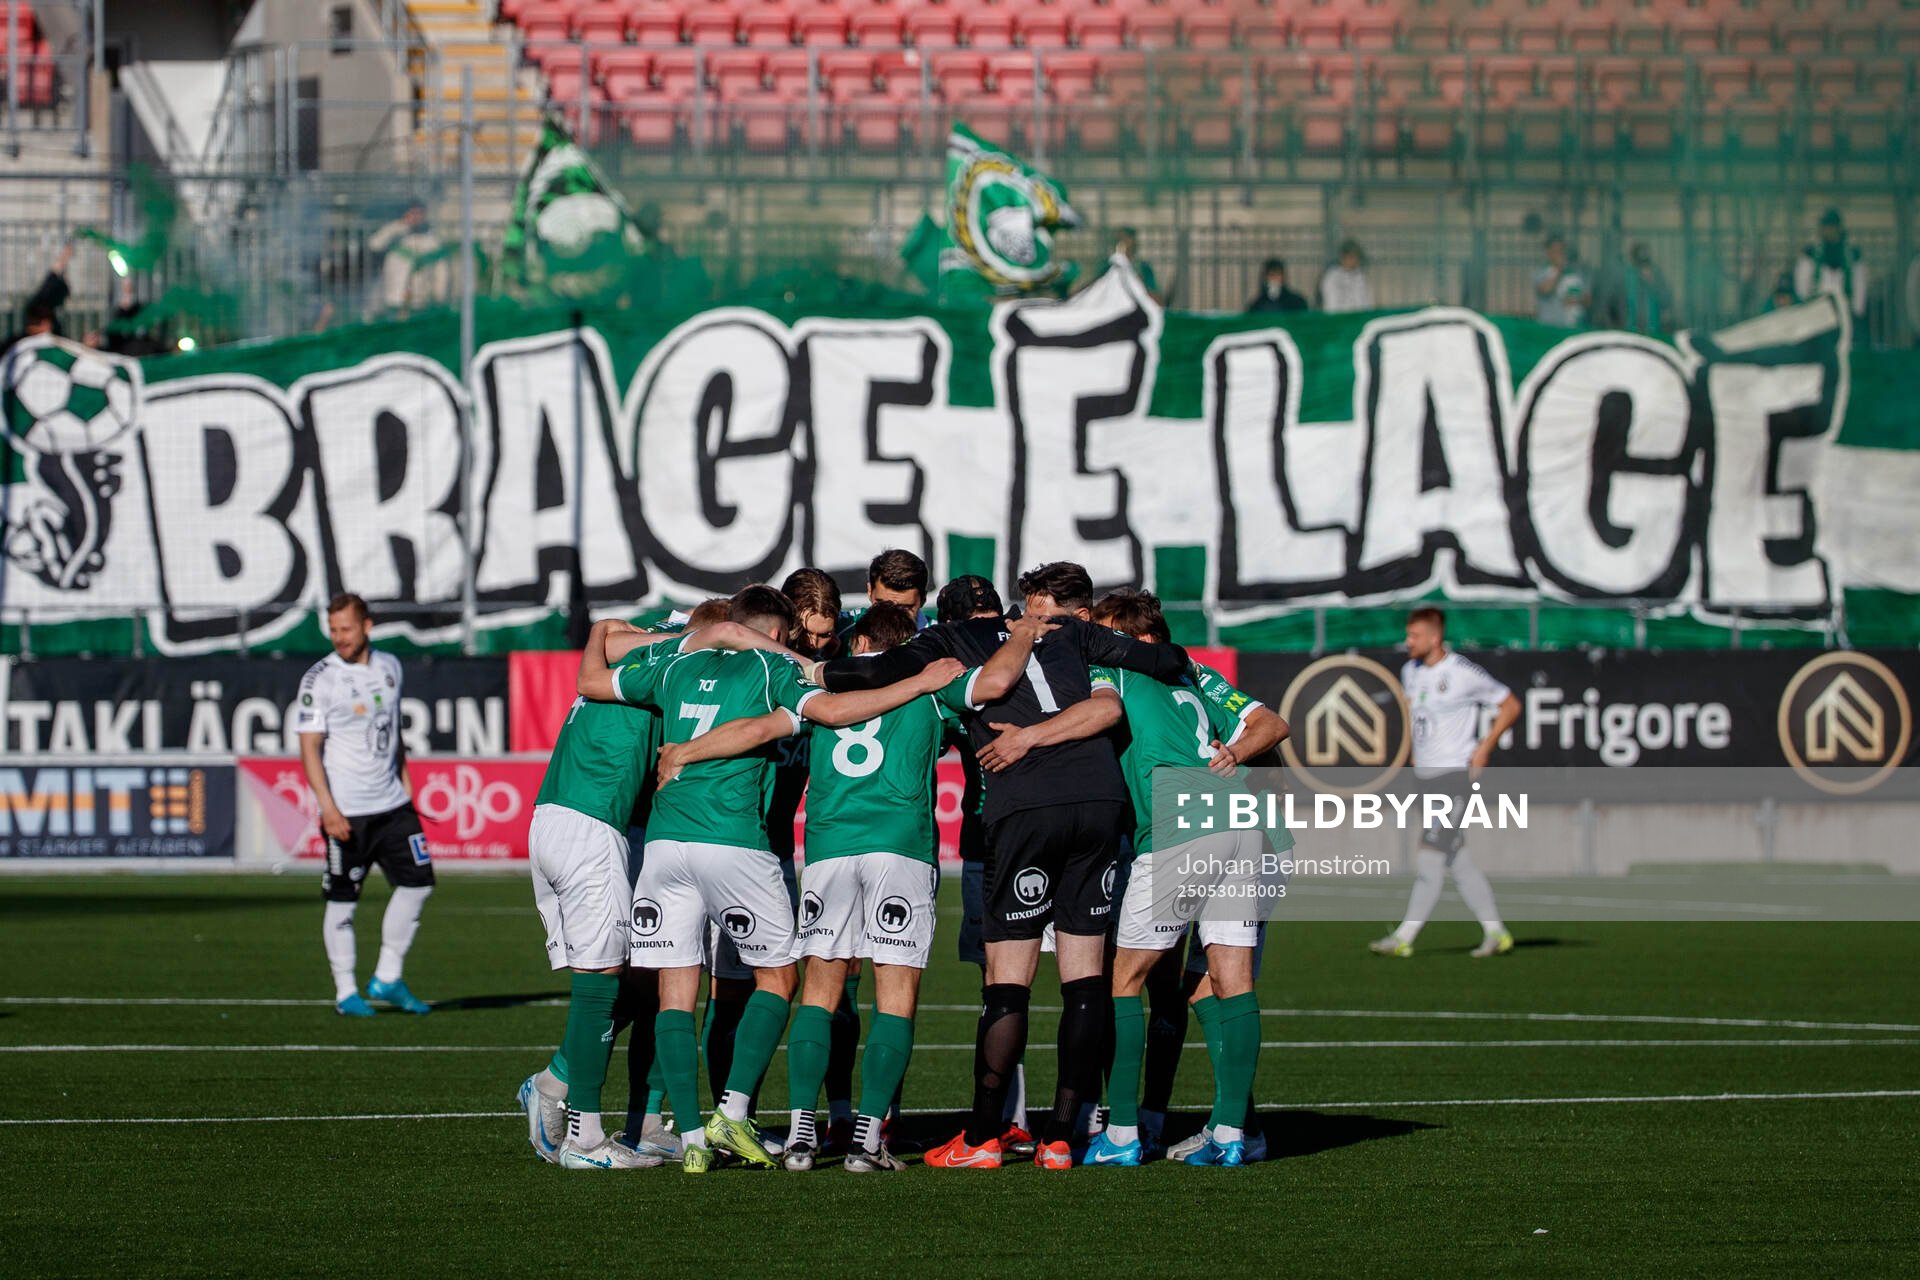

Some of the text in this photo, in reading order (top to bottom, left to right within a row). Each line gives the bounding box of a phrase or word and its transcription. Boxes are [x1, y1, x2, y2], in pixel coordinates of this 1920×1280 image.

[140, 312, 950, 648] BRAGE
[1025, 651, 1061, 713] 1
[674, 700, 721, 781] 7
[832, 714, 884, 778] 8
[1525, 687, 1732, 767] Frigore
[418, 764, 522, 840] ÖBO
